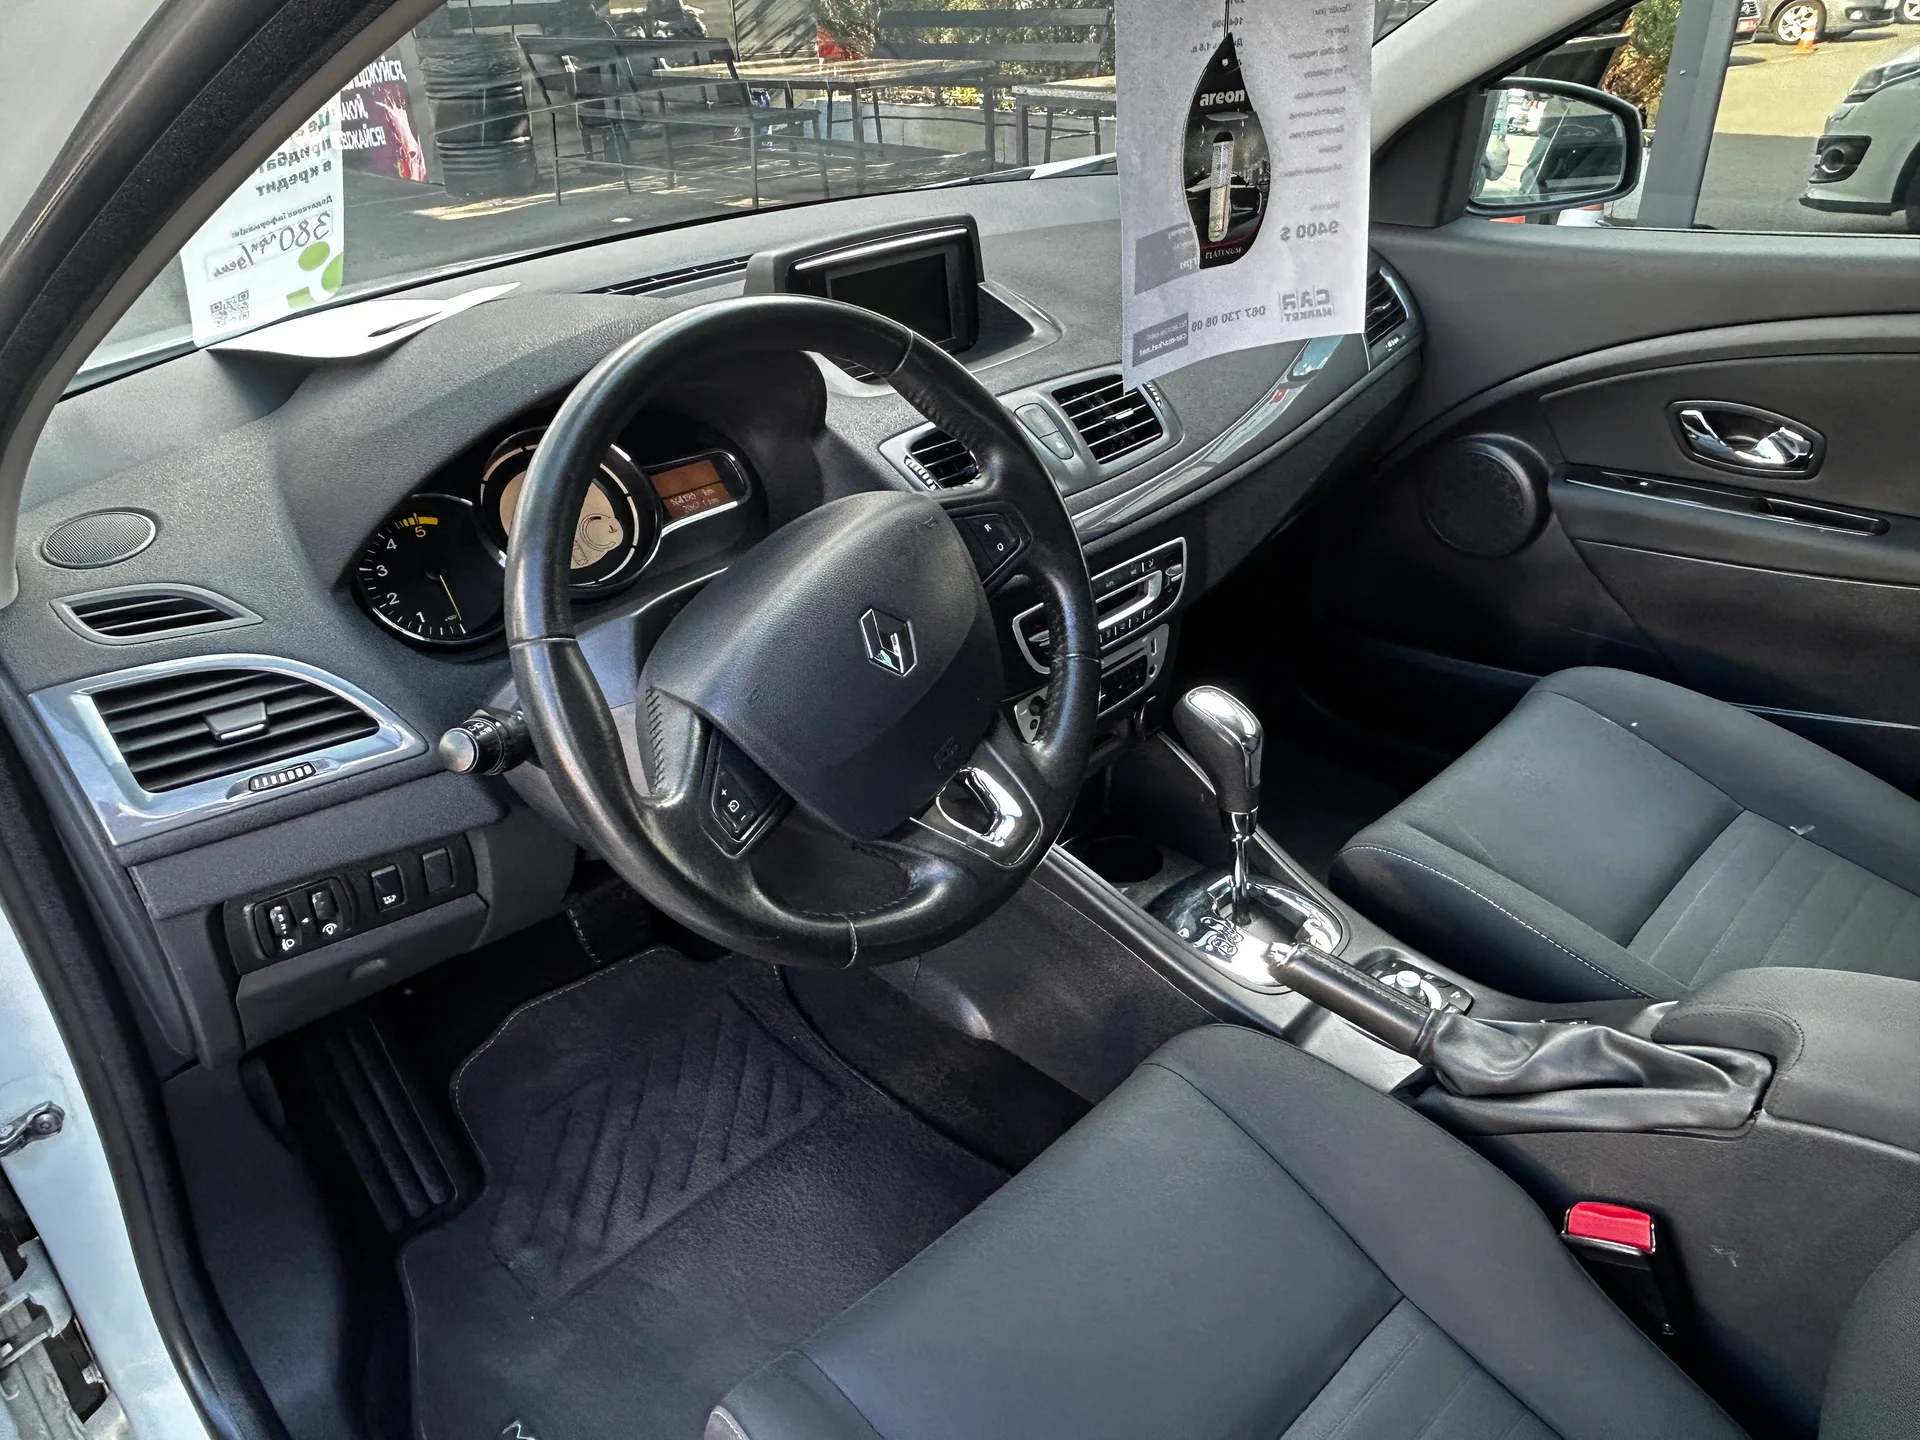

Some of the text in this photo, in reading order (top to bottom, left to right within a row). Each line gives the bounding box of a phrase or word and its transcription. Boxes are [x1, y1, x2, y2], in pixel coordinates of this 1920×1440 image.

[1199, 89, 1246, 107] areon
[414, 525, 427, 539] 5
[983, 523, 992, 532] R
[386, 538, 398, 551] 4
[376, 564, 389, 577] 3
[386, 592, 400, 606] 2
[415, 611, 426, 623] 1
